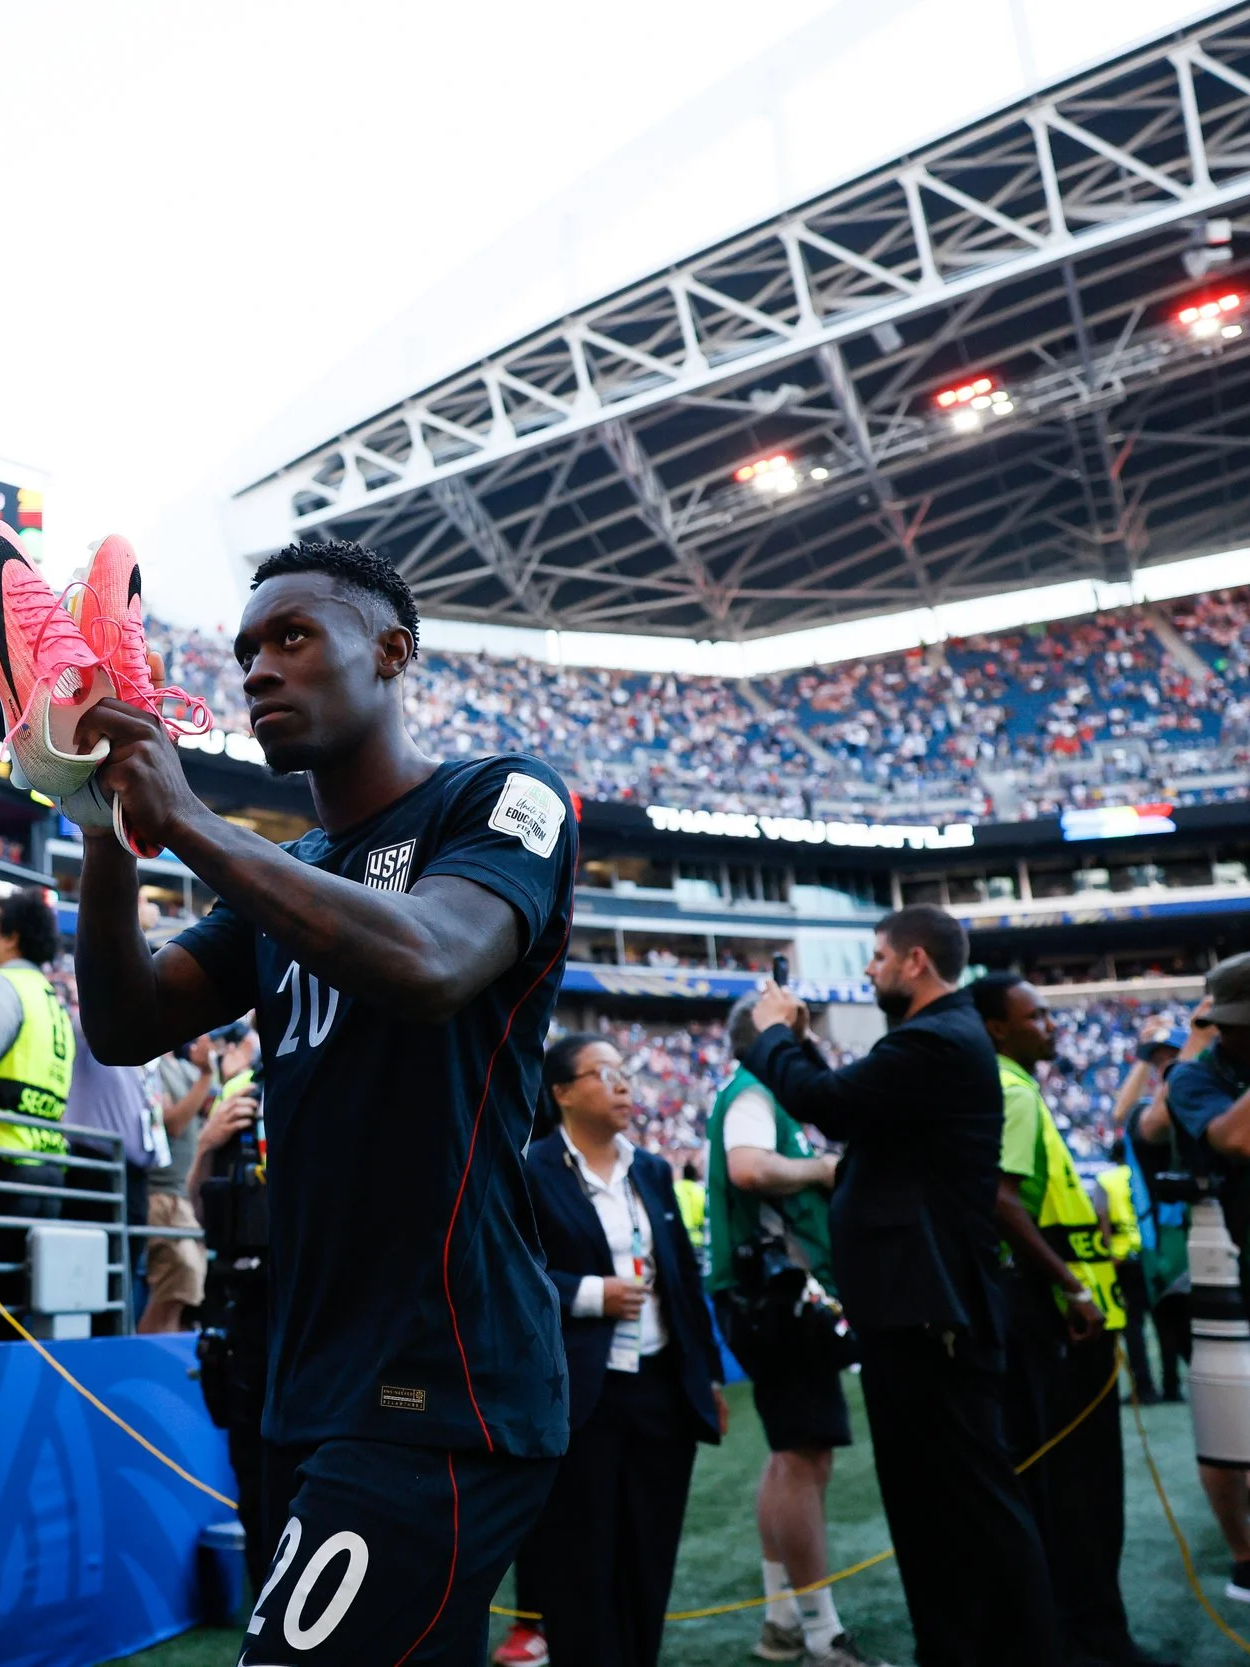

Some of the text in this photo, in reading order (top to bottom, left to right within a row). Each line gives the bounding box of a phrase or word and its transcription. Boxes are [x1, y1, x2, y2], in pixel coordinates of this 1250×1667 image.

[505, 806, 547, 841] EDUCATION
[516, 823, 531, 837] FIFA
[369, 845, 412, 878] USA
[246, 1516, 369, 1651] 20
